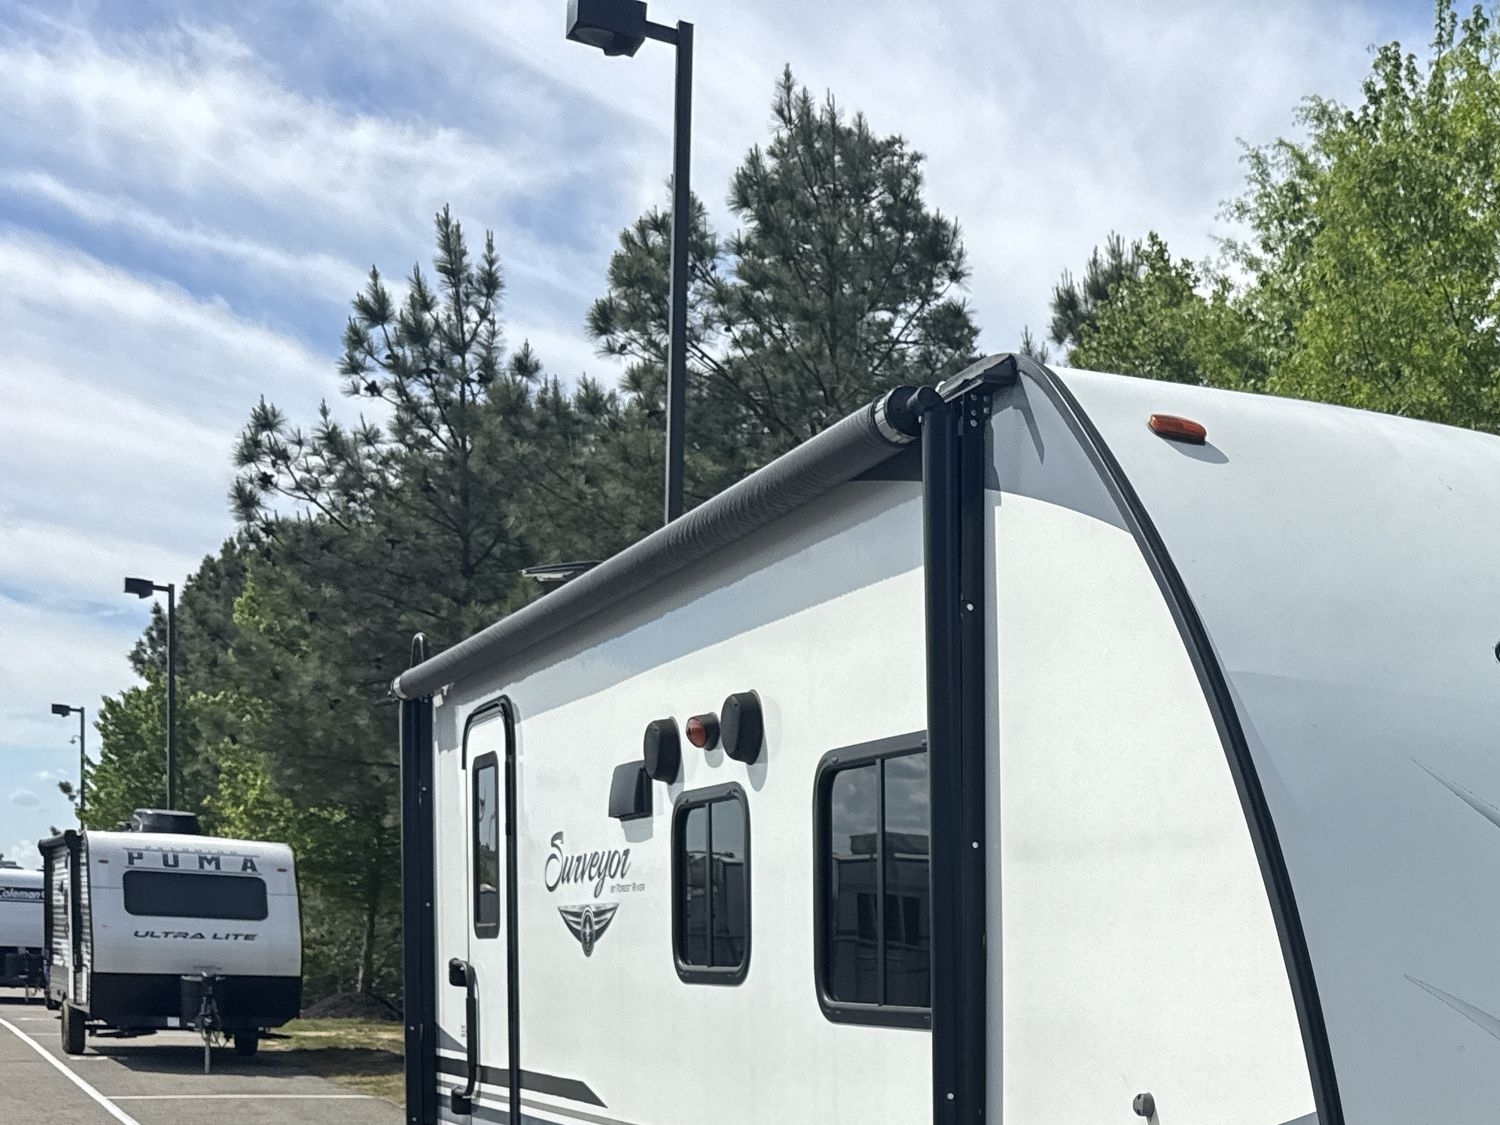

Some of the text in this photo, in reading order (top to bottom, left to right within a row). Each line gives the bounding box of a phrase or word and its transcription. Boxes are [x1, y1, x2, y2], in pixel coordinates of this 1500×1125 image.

[128, 851, 258, 873] PUMA
[545, 831, 632, 898] Surveyor
[134, 930, 258, 942] ULTRA LITE
